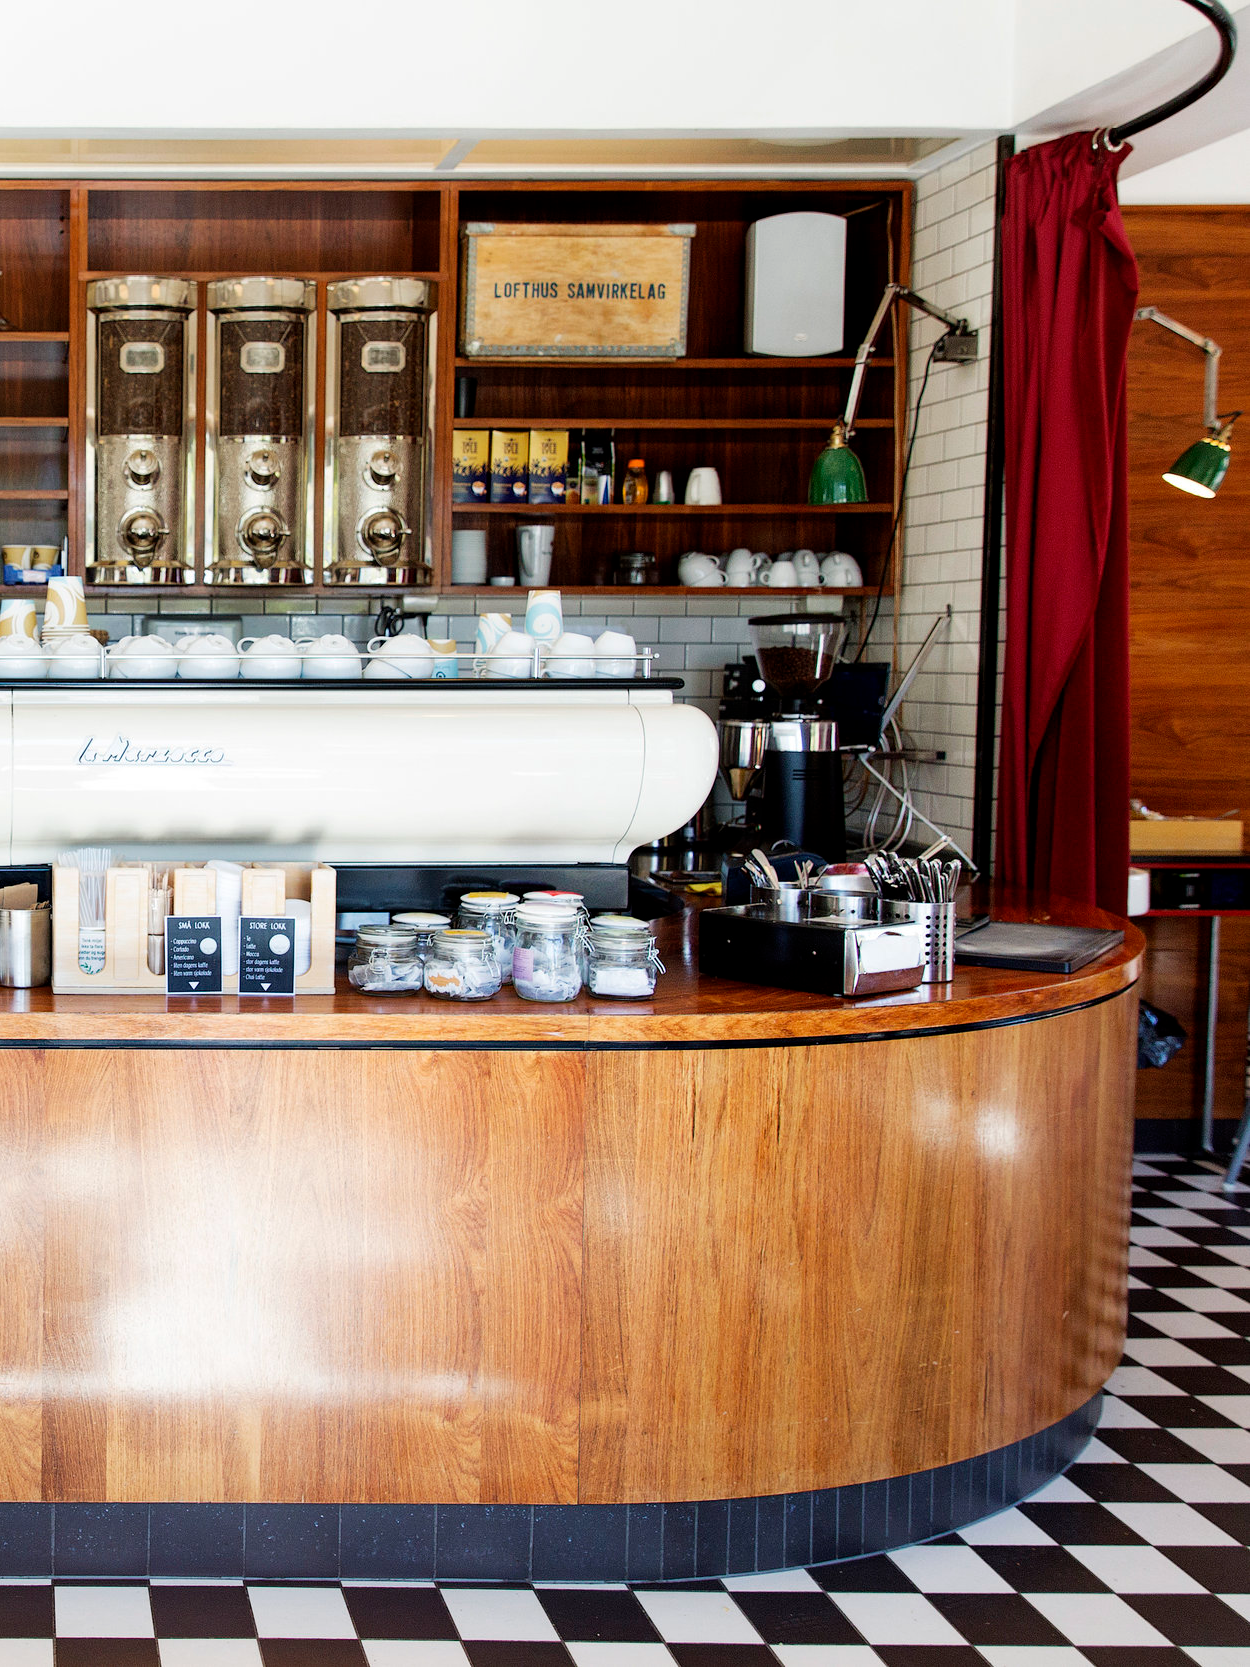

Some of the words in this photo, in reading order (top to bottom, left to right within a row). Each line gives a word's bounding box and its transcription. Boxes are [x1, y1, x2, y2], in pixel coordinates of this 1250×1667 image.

[494, 282, 558, 298] LOFTHUS
[567, 283, 666, 299] SAMVIRKELAG
[178, 920, 192, 930] SMÅ
[194, 921, 211, 930] LOKK
[249, 921, 268, 930] STORE
[270, 922, 287, 931] LOKK
[172, 938, 197, 946] Cappuccino
